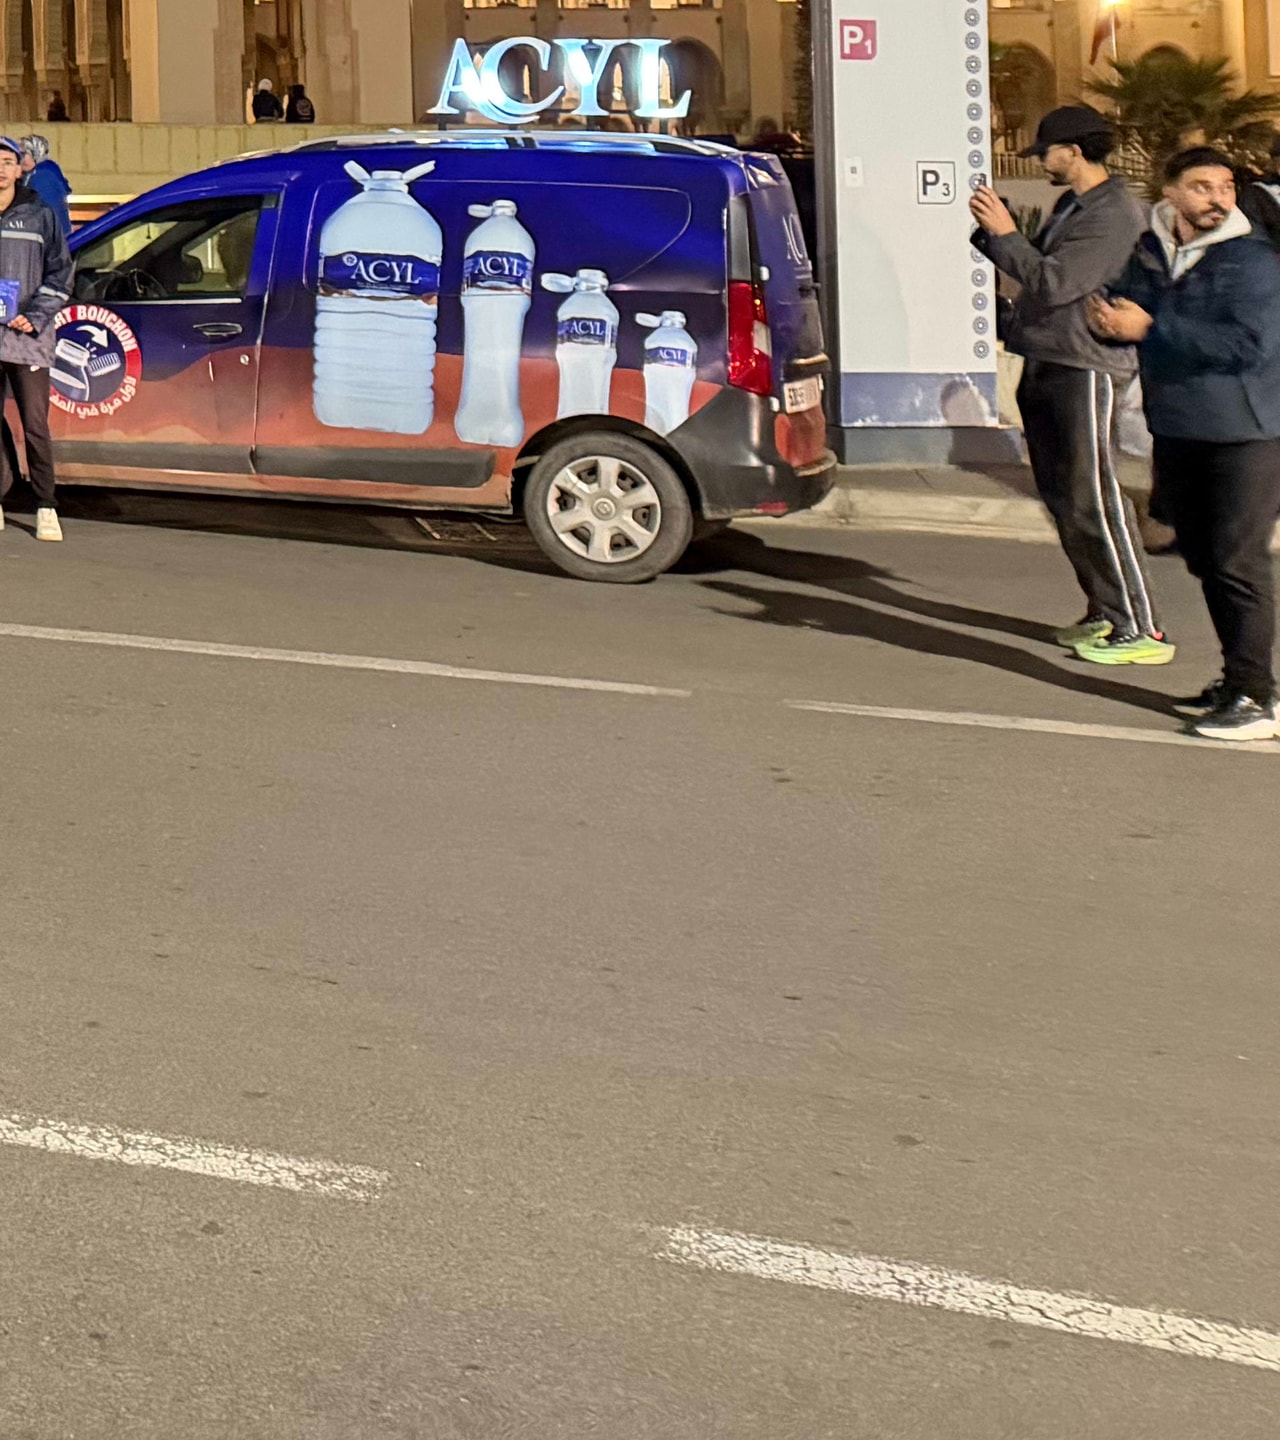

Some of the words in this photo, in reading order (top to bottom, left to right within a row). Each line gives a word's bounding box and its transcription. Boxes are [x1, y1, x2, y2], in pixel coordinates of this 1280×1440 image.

[427, 36, 692, 124] ACYL
[351, 259, 422, 284] ACYL
[474, 256, 524, 277] ACYL
[77, 305, 138, 352] BOUCHON
[570, 320, 605, 336] ACYL
[657, 349, 684, 361] ACYL
[77, 404, 99, 419] في
